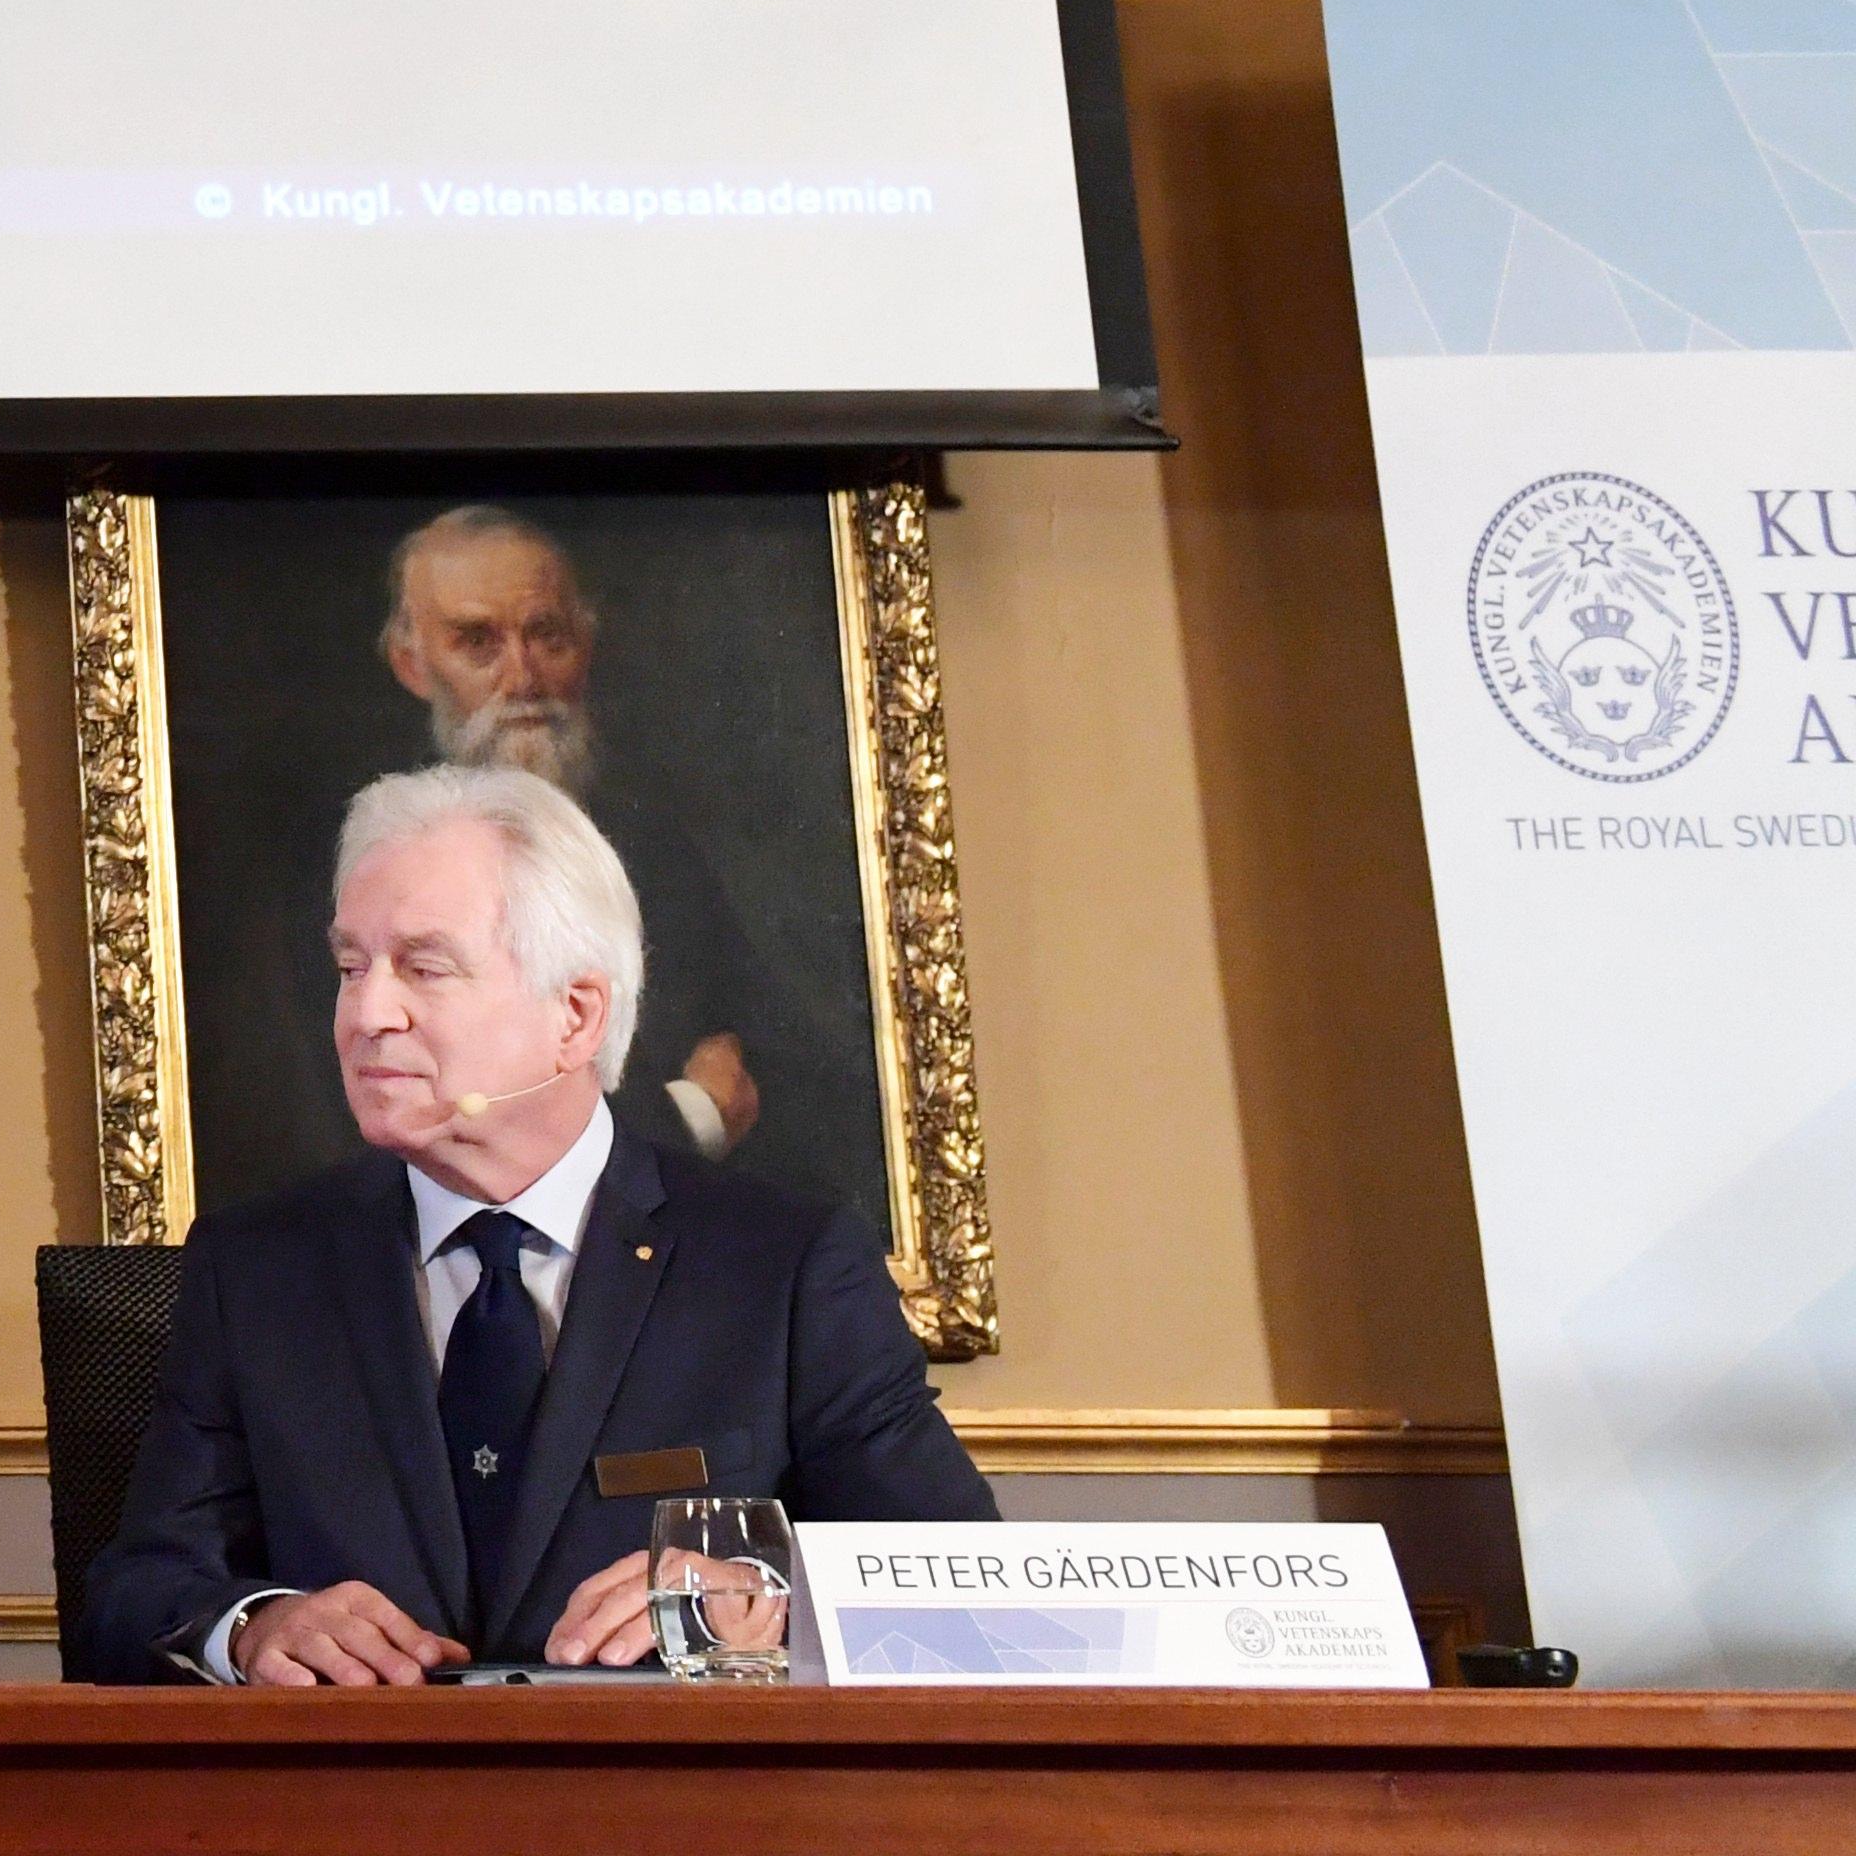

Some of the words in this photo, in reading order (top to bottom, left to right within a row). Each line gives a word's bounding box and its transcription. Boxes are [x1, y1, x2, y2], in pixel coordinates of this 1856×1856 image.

[263, 181, 404, 226] Kungl.
[419, 179, 933, 224] Vetenskapsakademien
[1483, 584, 1528, 695] KUNGL.
[1505, 816, 1586, 851] THE
[1597, 815, 1724, 850] ROYAL
[856, 1554, 1009, 1589] PETER
[1024, 1548, 1348, 1589] GÄRDENFORS
